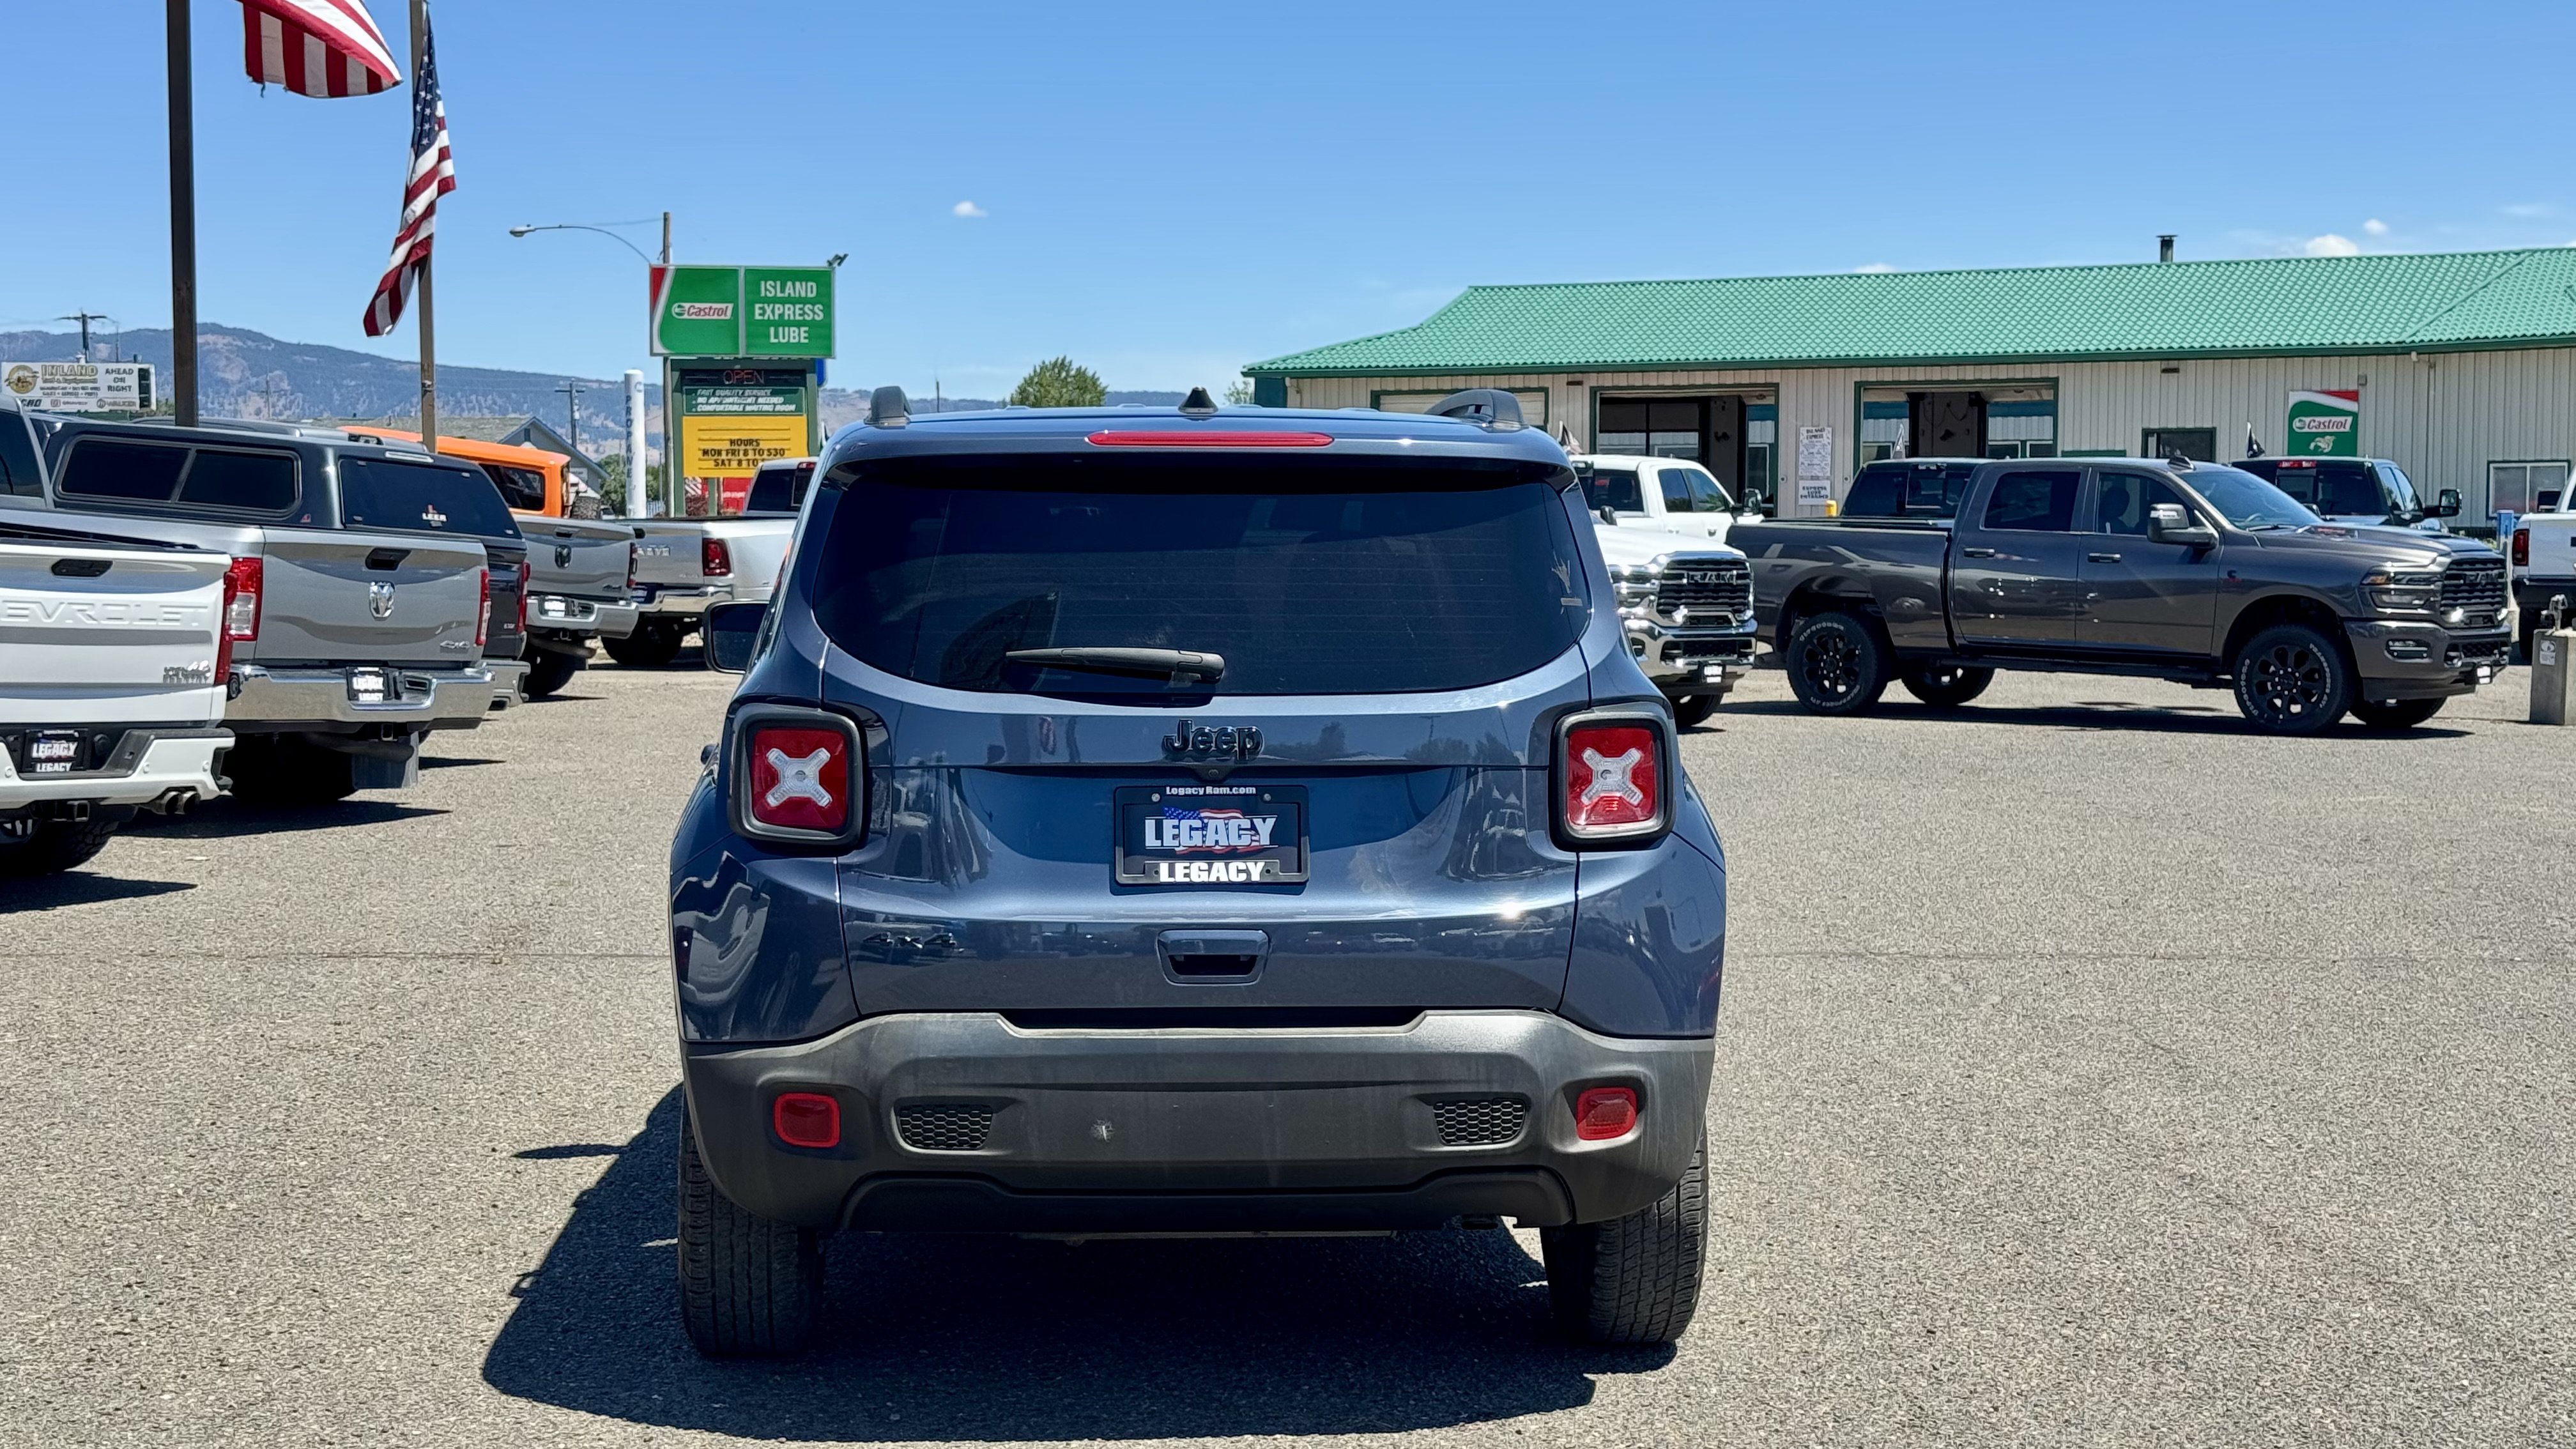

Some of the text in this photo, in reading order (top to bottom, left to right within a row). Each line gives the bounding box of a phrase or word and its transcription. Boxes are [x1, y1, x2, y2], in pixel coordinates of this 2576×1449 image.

[760, 280, 817, 298] ISLAND
[687, 305, 729, 318] Castrol
[755, 303, 824, 321] EXPRESS
[769, 326, 809, 343] LUBE
[41, 364, 98, 376] INLAND
[723, 370, 764, 385] OPEN
[2307, 418, 2348, 430] Castrol
[625, 395, 634, 479] PROPANE
[730, 438, 760, 447] HOURS
[702, 448, 722, 457] MON
[726, 448, 740, 457] FRI
[753, 448, 765, 457] TO
[767, 448, 785, 457] 530
[714, 459, 732, 467] SAT
[737, 459, 743, 467] 8
[747, 459, 758, 467] TO
[1162, 719, 1264, 760] Jeep
[32, 742, 78, 758] LEGACY
[36, 762, 72, 772] LEGACY
[1145, 818, 1277, 847] LEGACY
[1160, 862, 1265, 882] LEGACY
